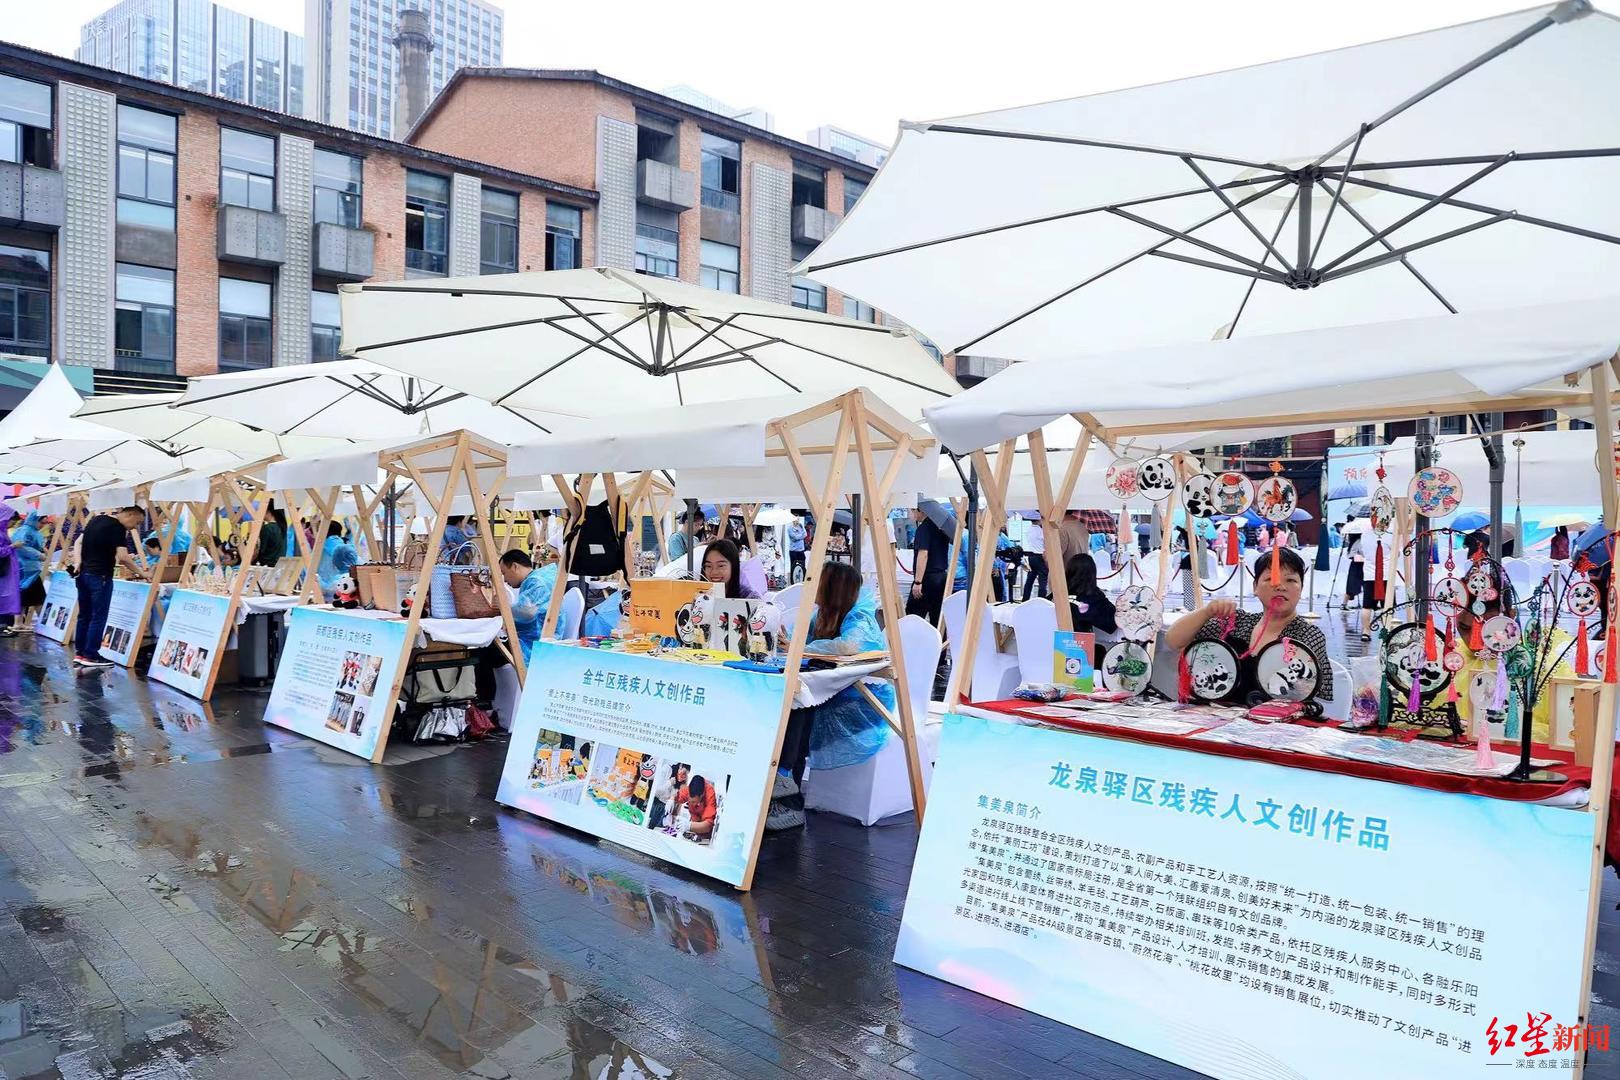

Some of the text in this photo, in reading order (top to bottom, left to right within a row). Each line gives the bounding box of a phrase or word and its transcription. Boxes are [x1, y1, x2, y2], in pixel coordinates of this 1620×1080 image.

[582, 668, 706, 706] 金牛区残疾人文创作品
[976, 794, 1042, 820] 集美泉简介
[1047, 761, 1390, 851] 龙泉驿区残疾人文创作品
